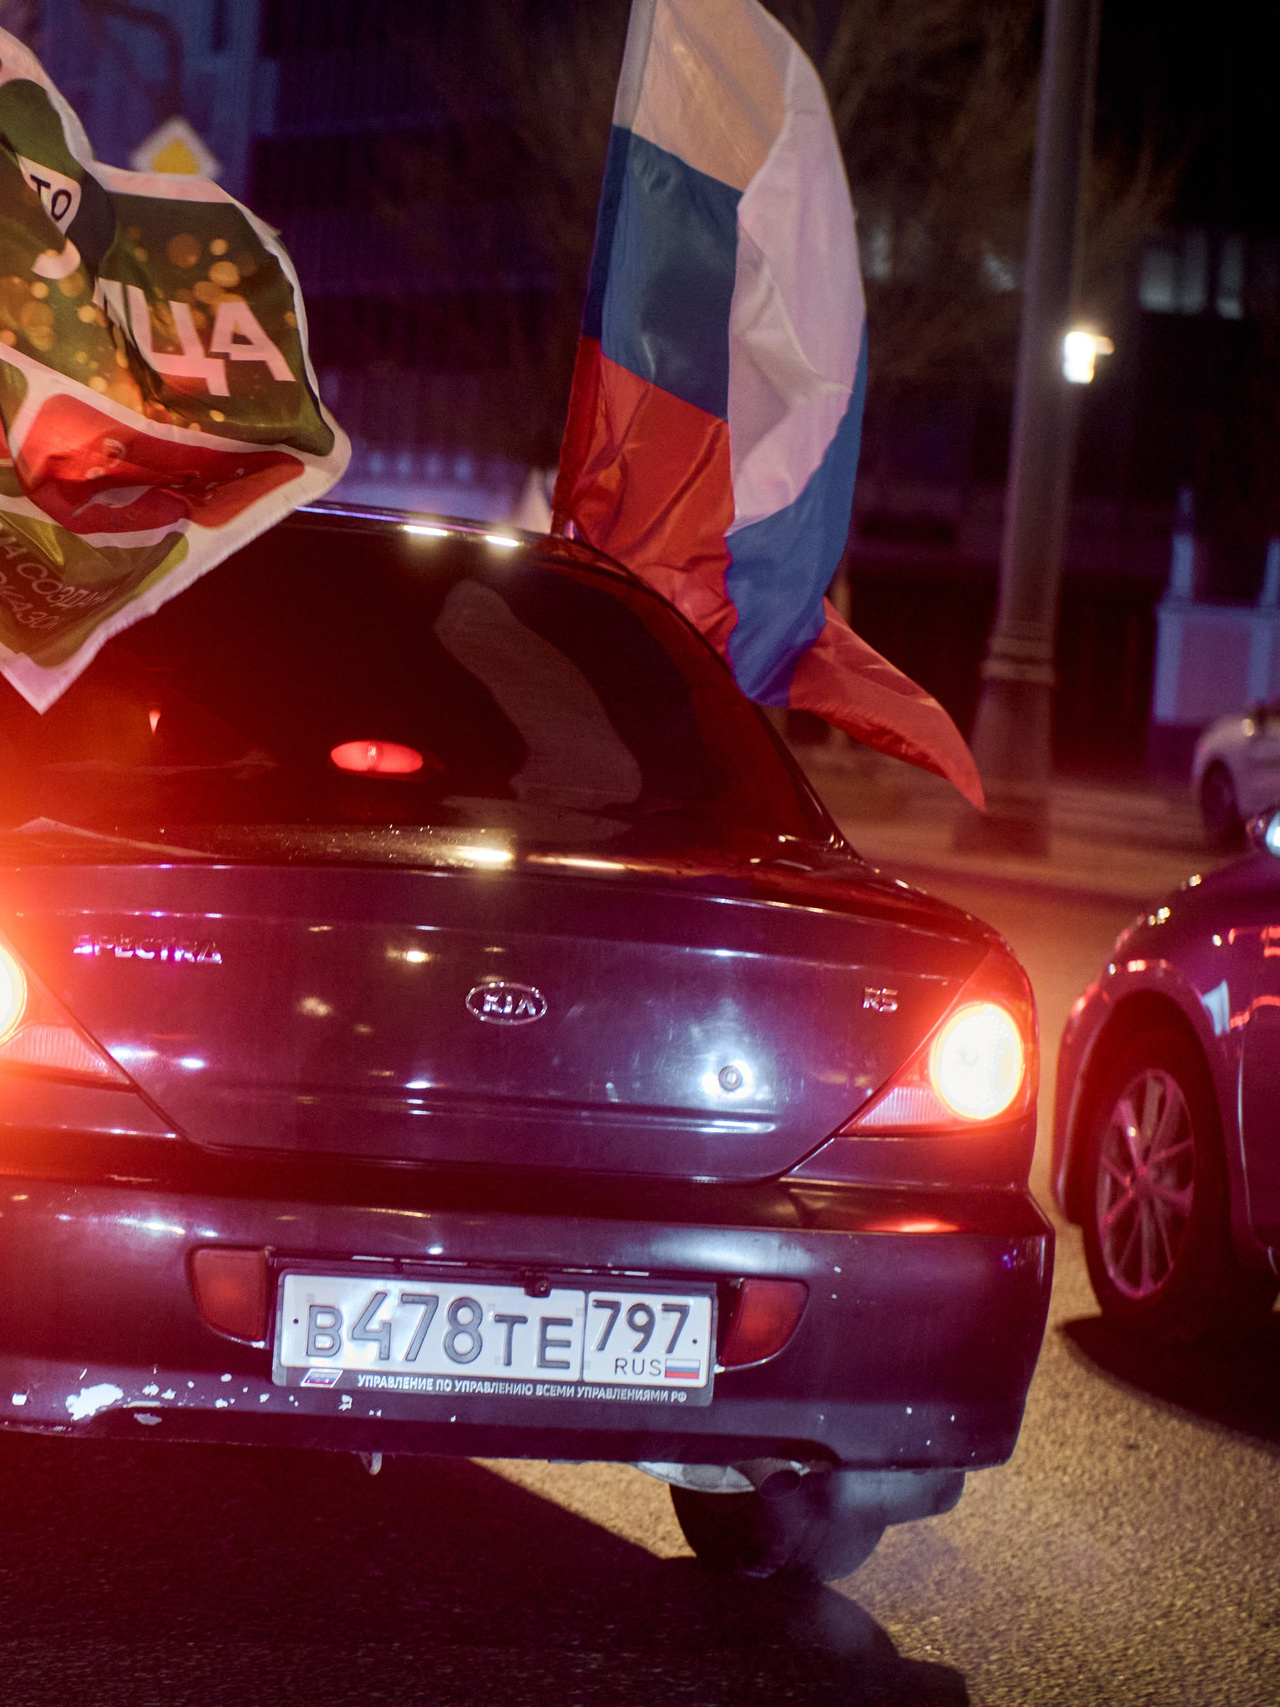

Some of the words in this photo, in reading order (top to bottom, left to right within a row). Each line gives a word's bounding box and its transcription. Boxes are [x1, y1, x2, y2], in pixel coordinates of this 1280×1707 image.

[72, 934, 222, 964] SPECTRA
[482, 991, 536, 1016] KIA
[592, 1299, 690, 1354] 797
[614, 1357, 662, 1377] RUS
[357, 1374, 434, 1390] УПРАВЛЕНИЕ
[435, 1378, 453, 1393] ПО
[454, 1380, 534, 1396] УПРАВЛЕНИЮ
[535, 1383, 575, 1398] ВСЕМИ
[576, 1386, 669, 1402] УПРАВЛЕНИЯМИ
[670, 1389, 688, 1404] РФ
